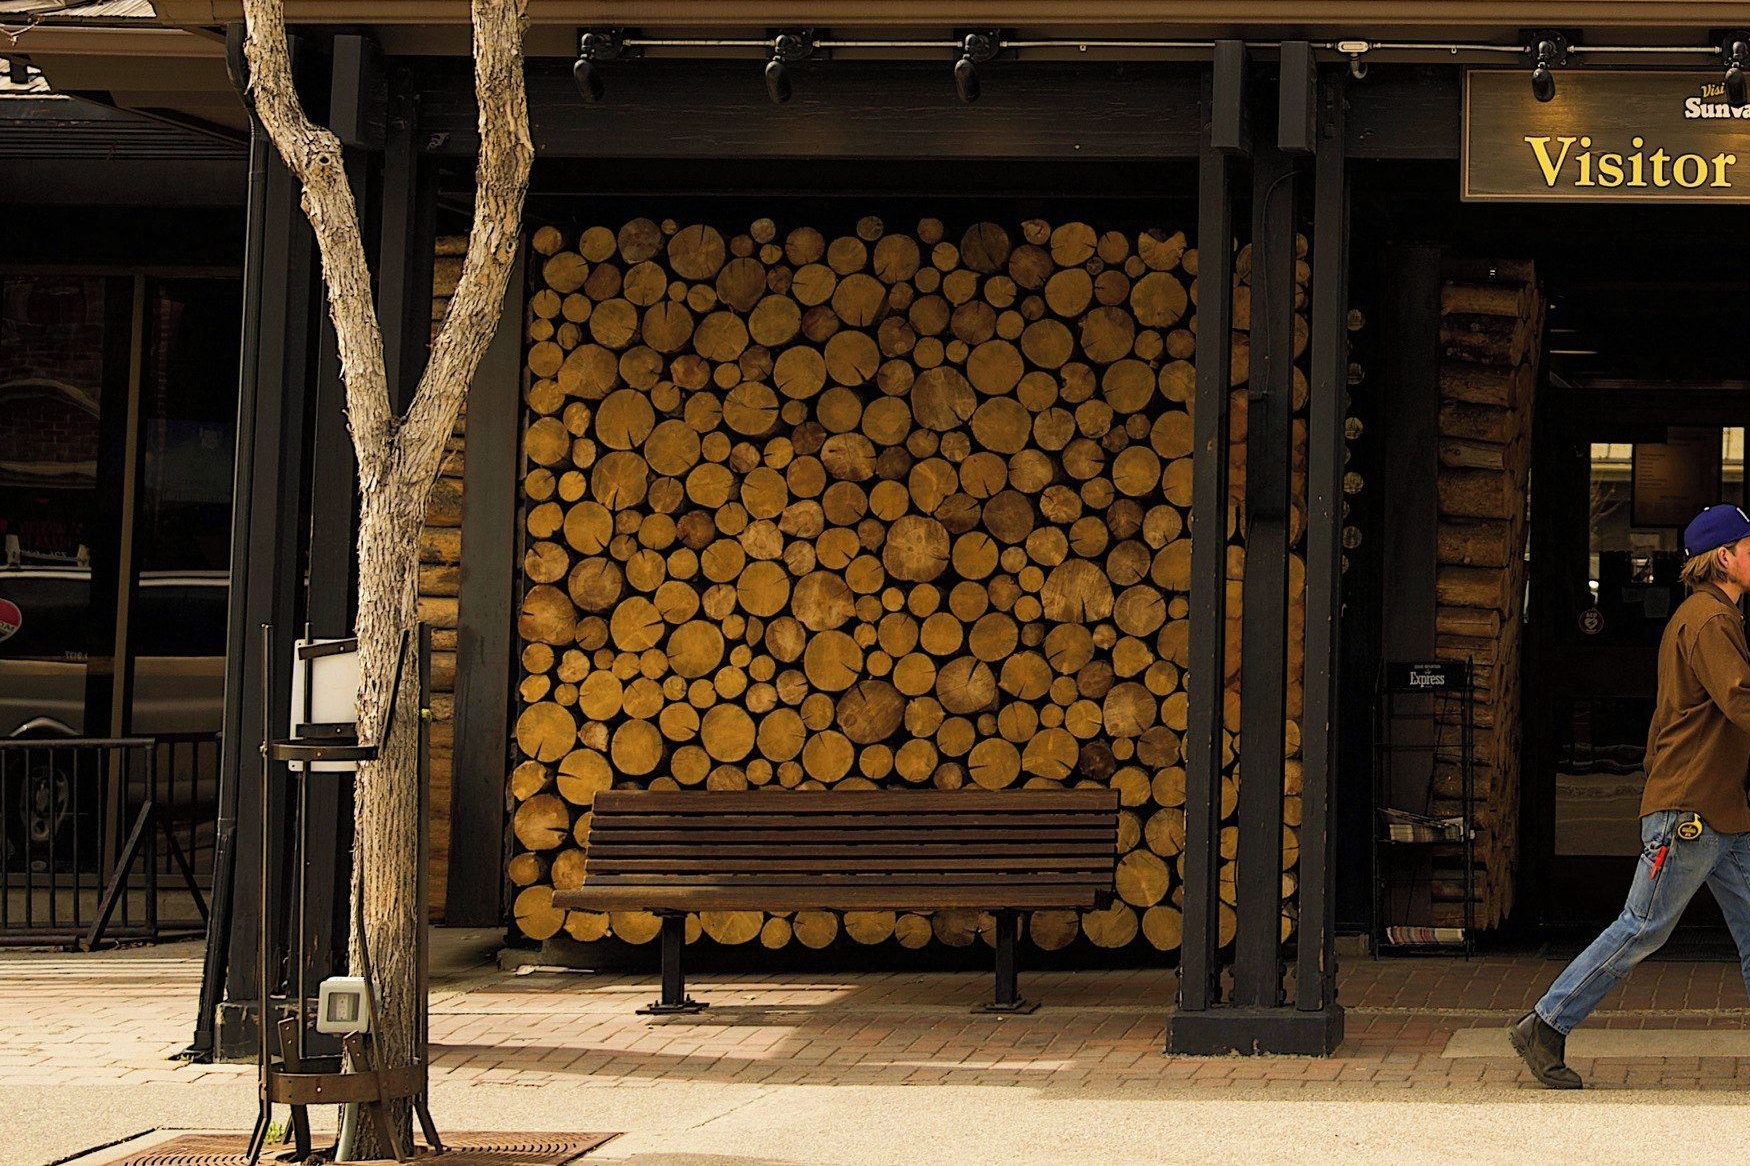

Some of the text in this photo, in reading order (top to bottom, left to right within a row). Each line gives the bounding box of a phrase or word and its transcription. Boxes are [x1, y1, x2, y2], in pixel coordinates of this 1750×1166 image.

[1701, 82, 1726, 98] Visi
[1524, 136, 1737, 188] Visitor
[1409, 671, 1445, 688] Express
